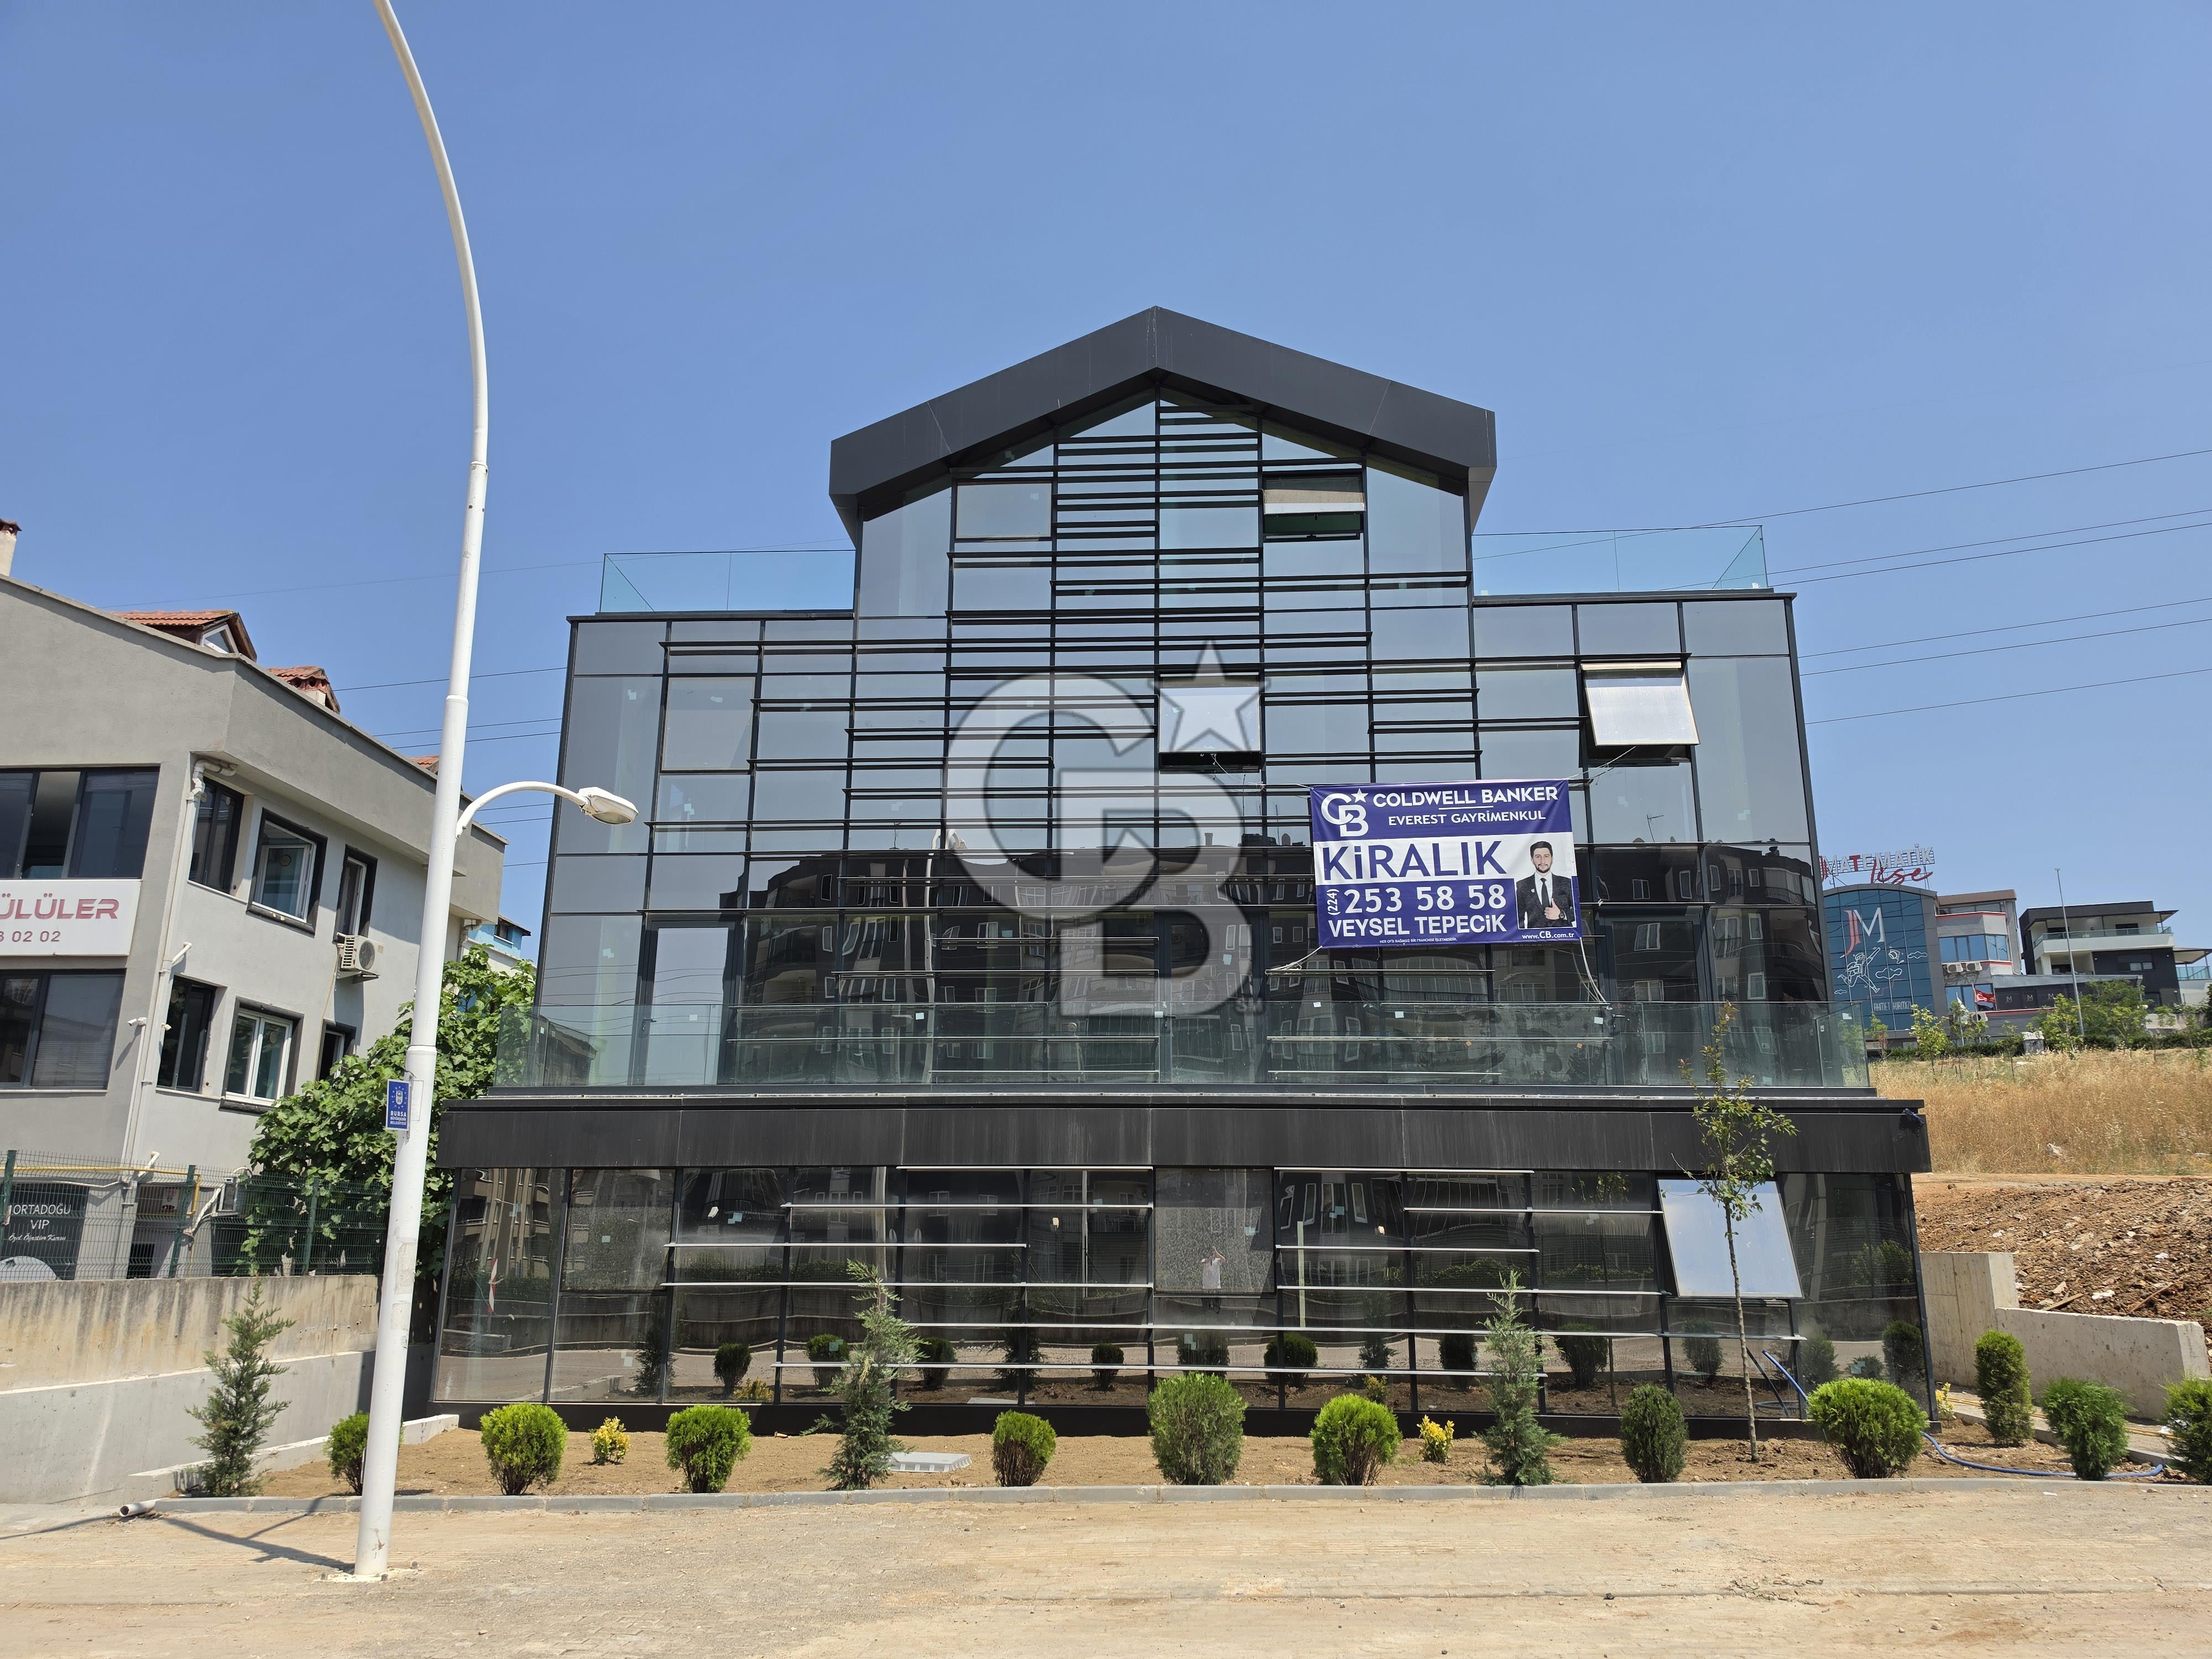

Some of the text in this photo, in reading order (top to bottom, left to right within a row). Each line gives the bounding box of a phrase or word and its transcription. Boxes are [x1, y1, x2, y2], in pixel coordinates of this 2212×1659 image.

[1373, 786, 1558, 807] COLDWELL BANKER
[1389, 810, 1546, 826] EVEREST GAYRİMENKUL
[1327, 889, 1340, 915] (224)
[1344, 884, 1507, 914] 253 58 58
[12, 931, 33, 942] 02
[39, 931, 61, 942] 02
[1328, 917, 1410, 938] VEYSEL
[1522, 931, 1575, 940] www.CB.com.tr
[30, 1219, 50, 1229] VIP
